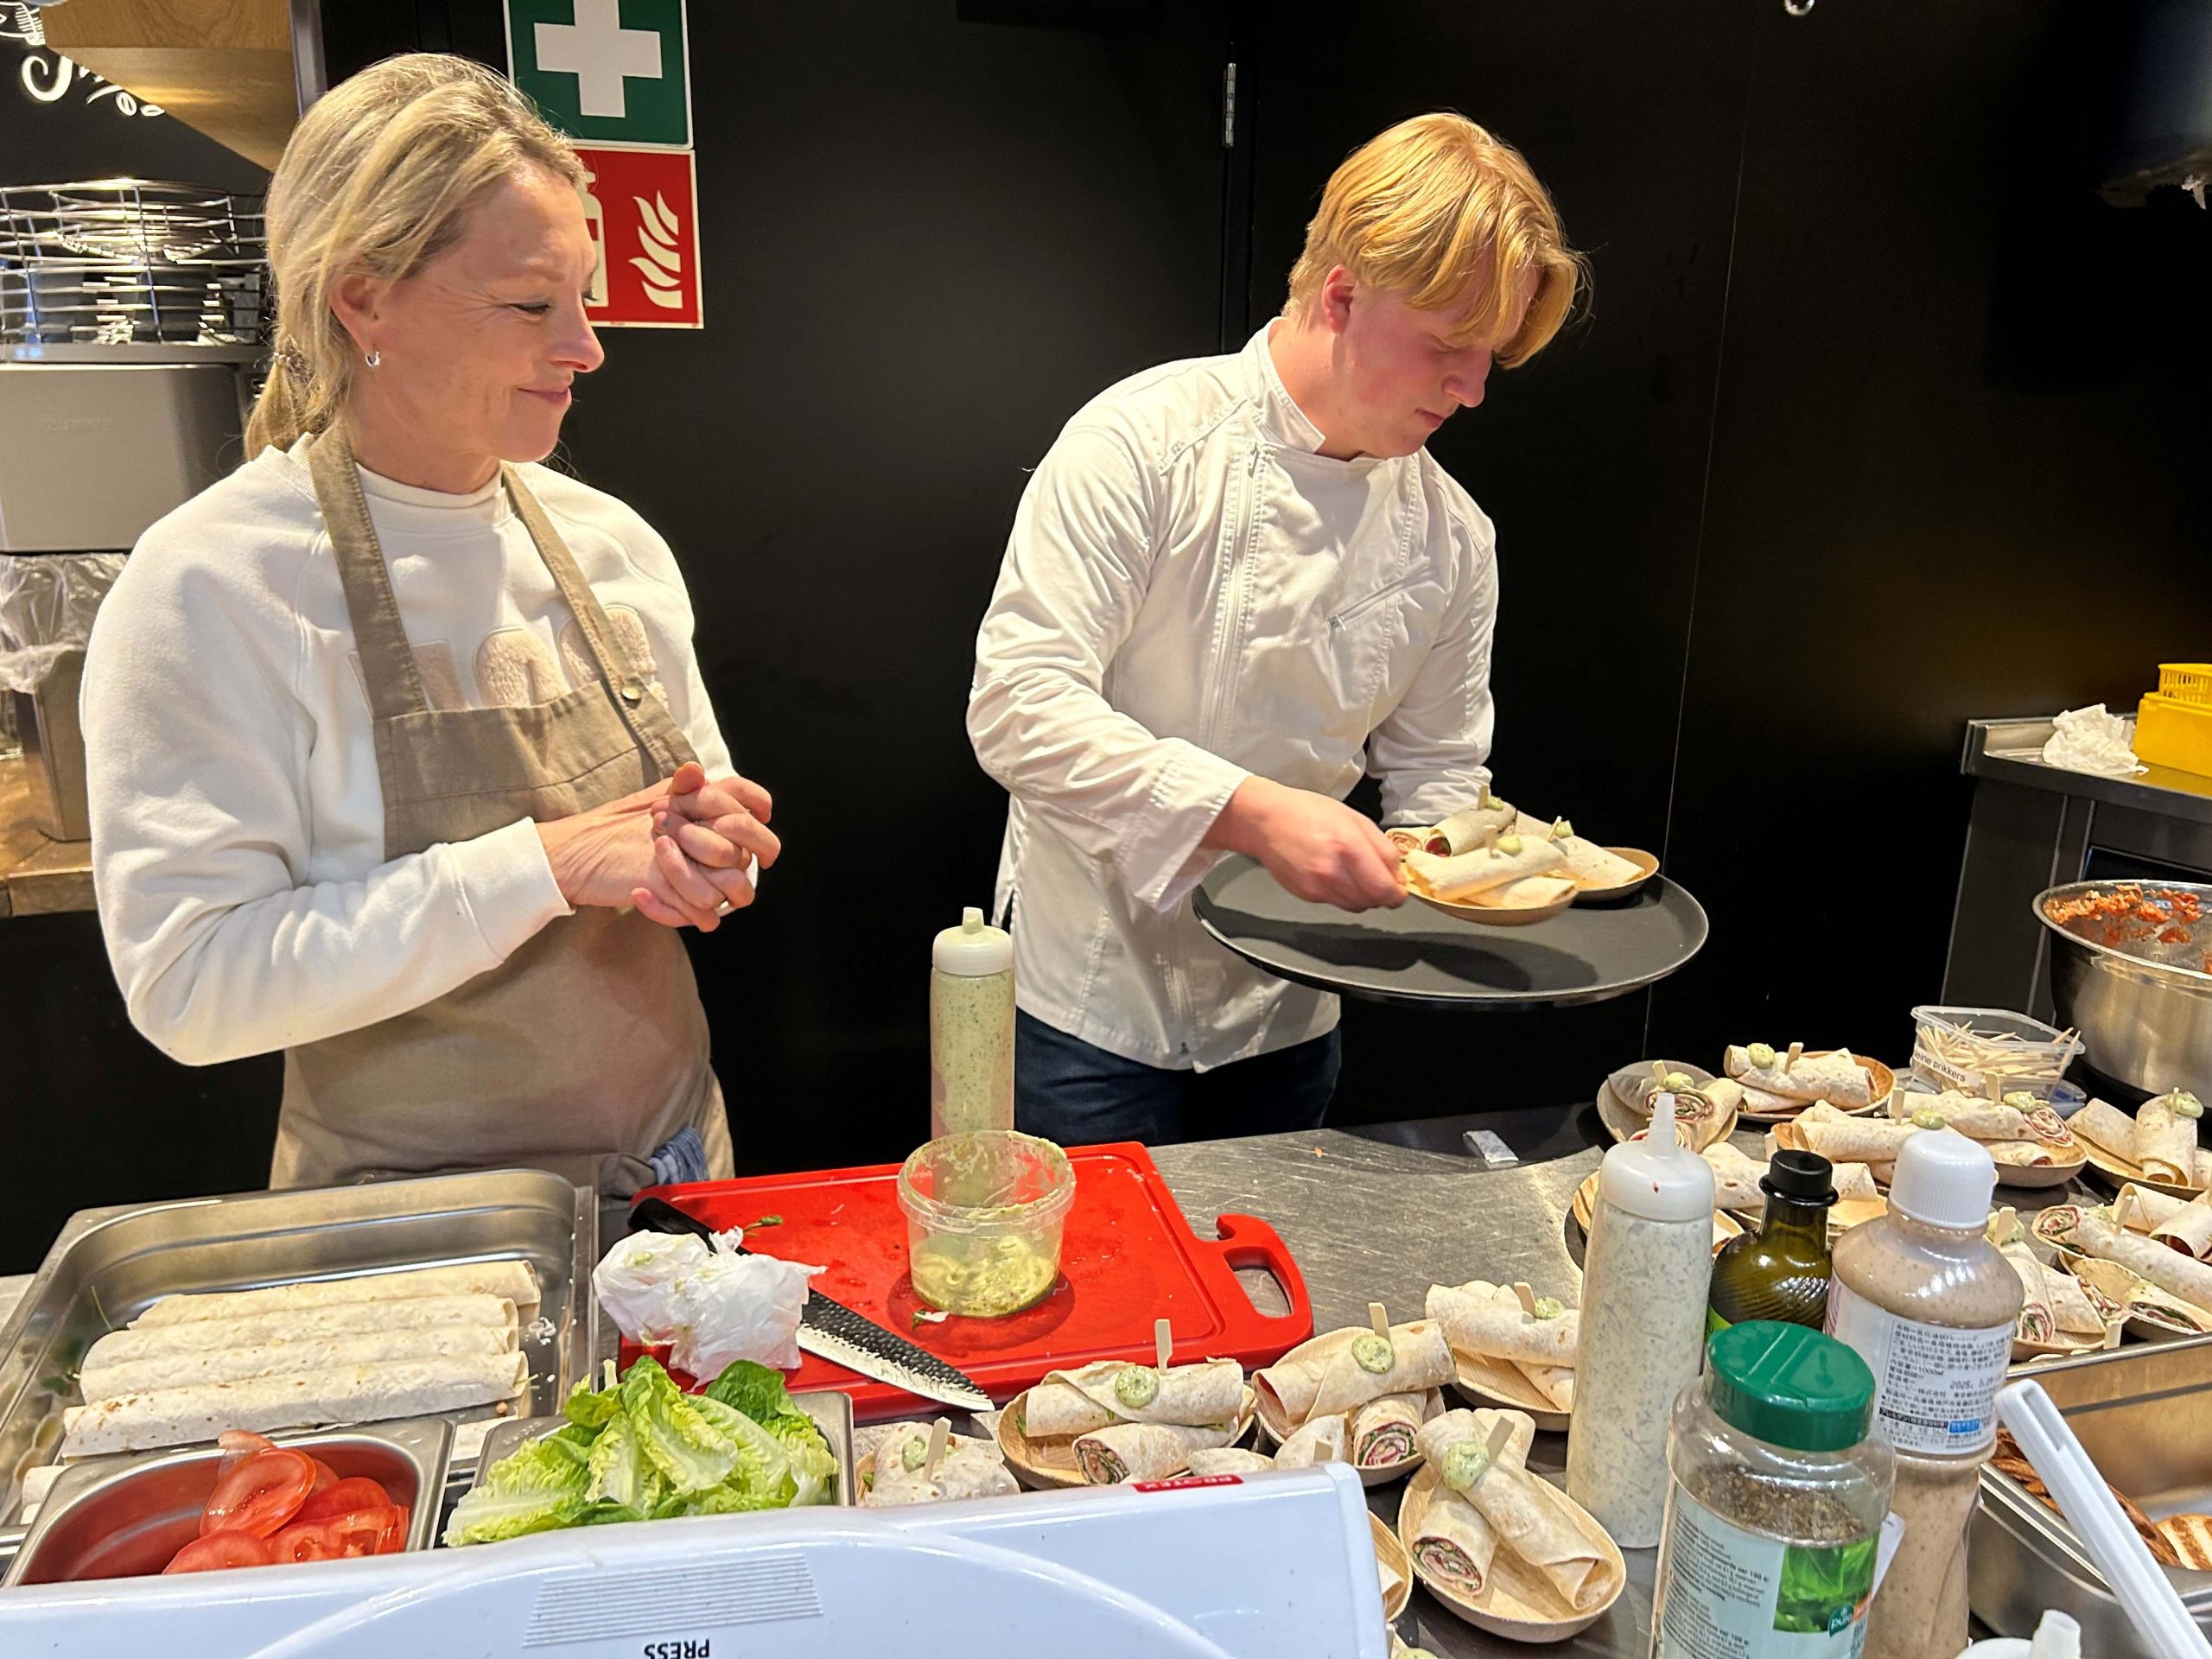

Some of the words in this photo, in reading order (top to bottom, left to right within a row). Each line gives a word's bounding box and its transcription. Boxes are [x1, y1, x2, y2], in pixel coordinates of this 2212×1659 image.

[1914, 1050, 1932, 1065] leine
[1933, 1060, 1966, 1082] prikkers
[644, 1638, 710, 1659] PRESS
